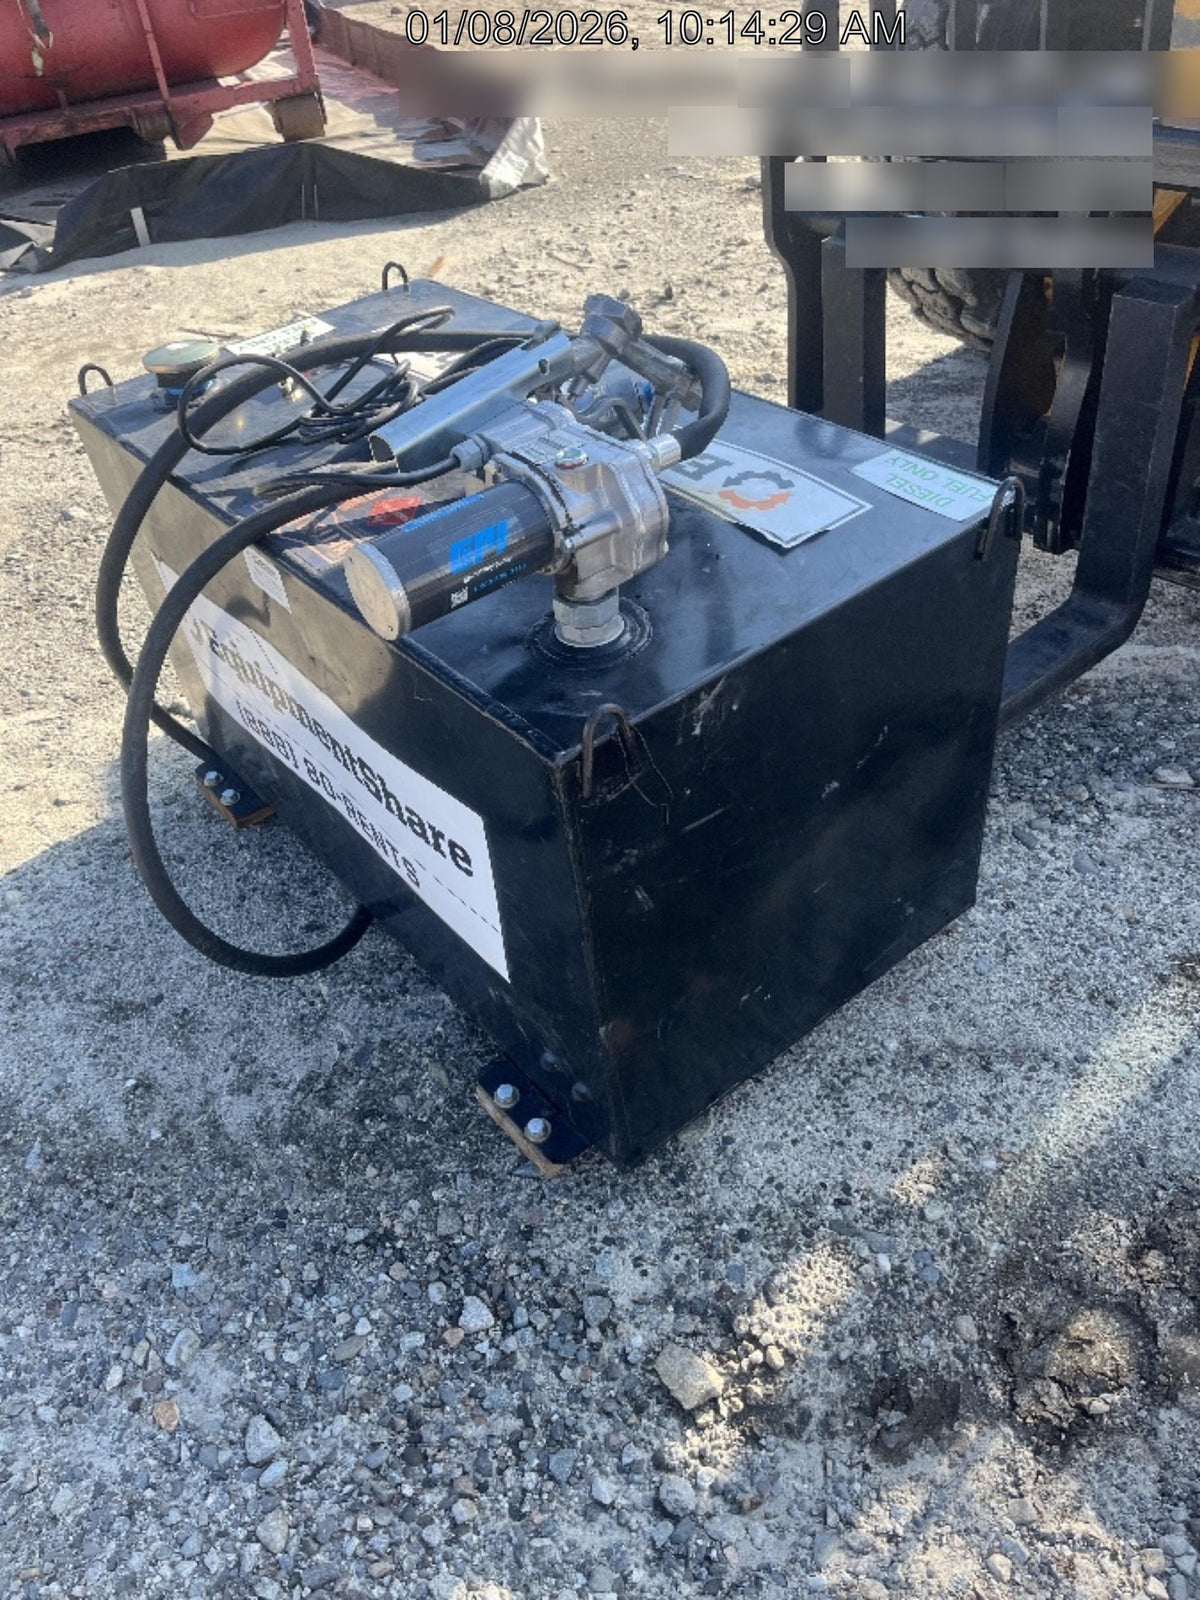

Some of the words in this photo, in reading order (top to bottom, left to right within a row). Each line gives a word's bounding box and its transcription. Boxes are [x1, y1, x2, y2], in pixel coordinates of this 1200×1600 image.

[887, 455, 941, 482] ONLY
[885, 473, 953, 507] DIESEL
[944, 477, 994, 503] FUEL
[200, 619, 474, 878] EquipmentShare
[235, 699, 300, 770] (888)
[303, 756, 421, 889] 80-RENTS
